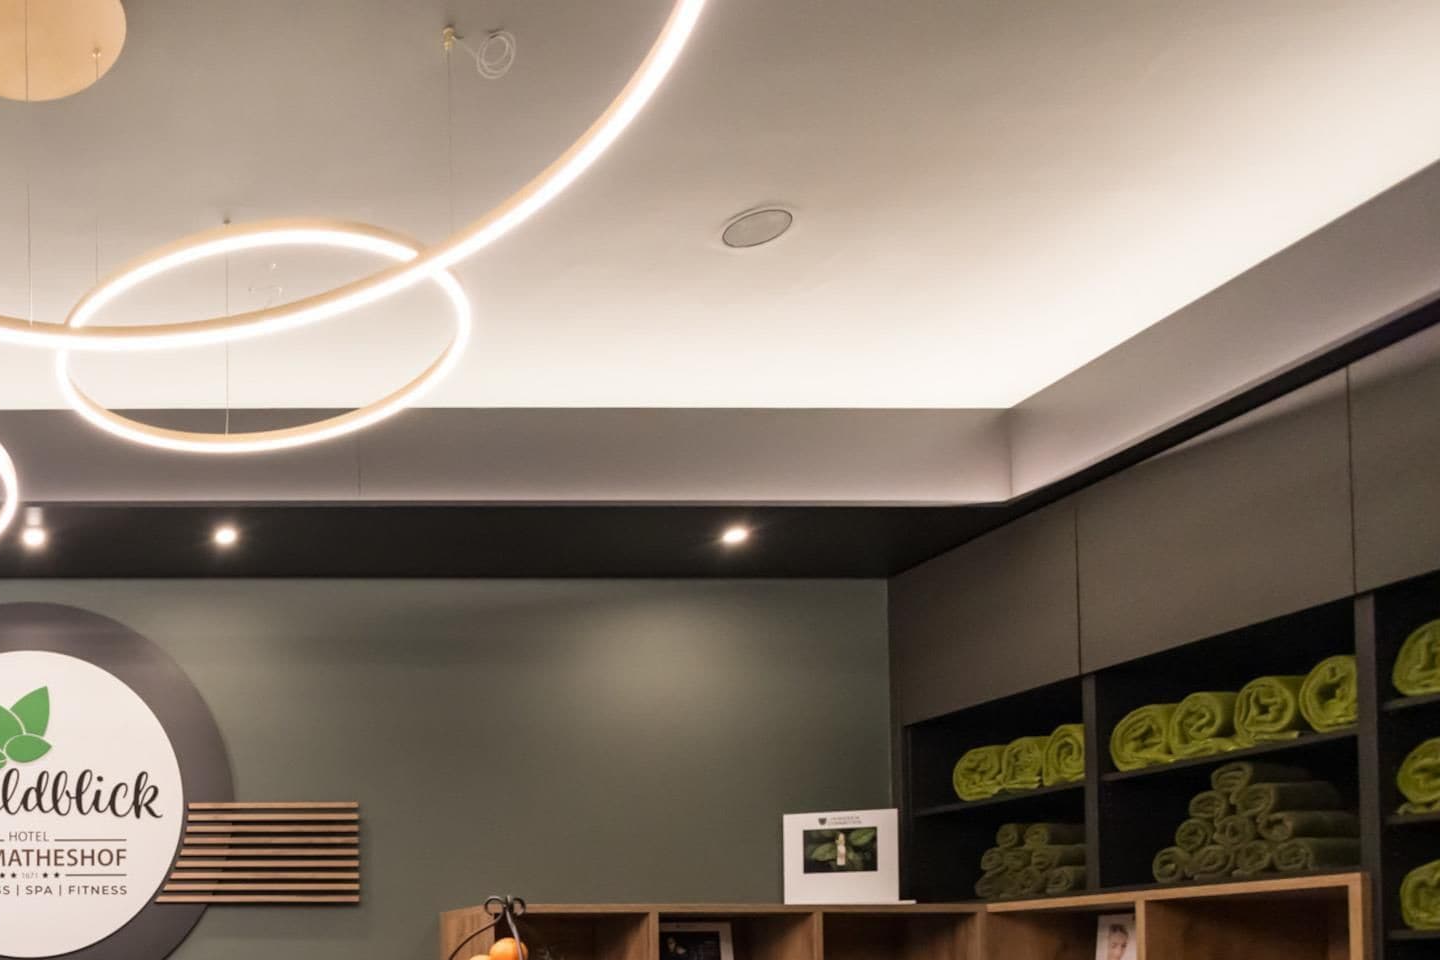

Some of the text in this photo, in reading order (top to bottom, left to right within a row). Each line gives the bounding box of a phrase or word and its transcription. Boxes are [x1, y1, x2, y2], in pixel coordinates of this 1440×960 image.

[8, 831, 49, 842] HOTEL
[25, 885, 53, 896] SPA
[68, 885, 127, 896] FITNESS
